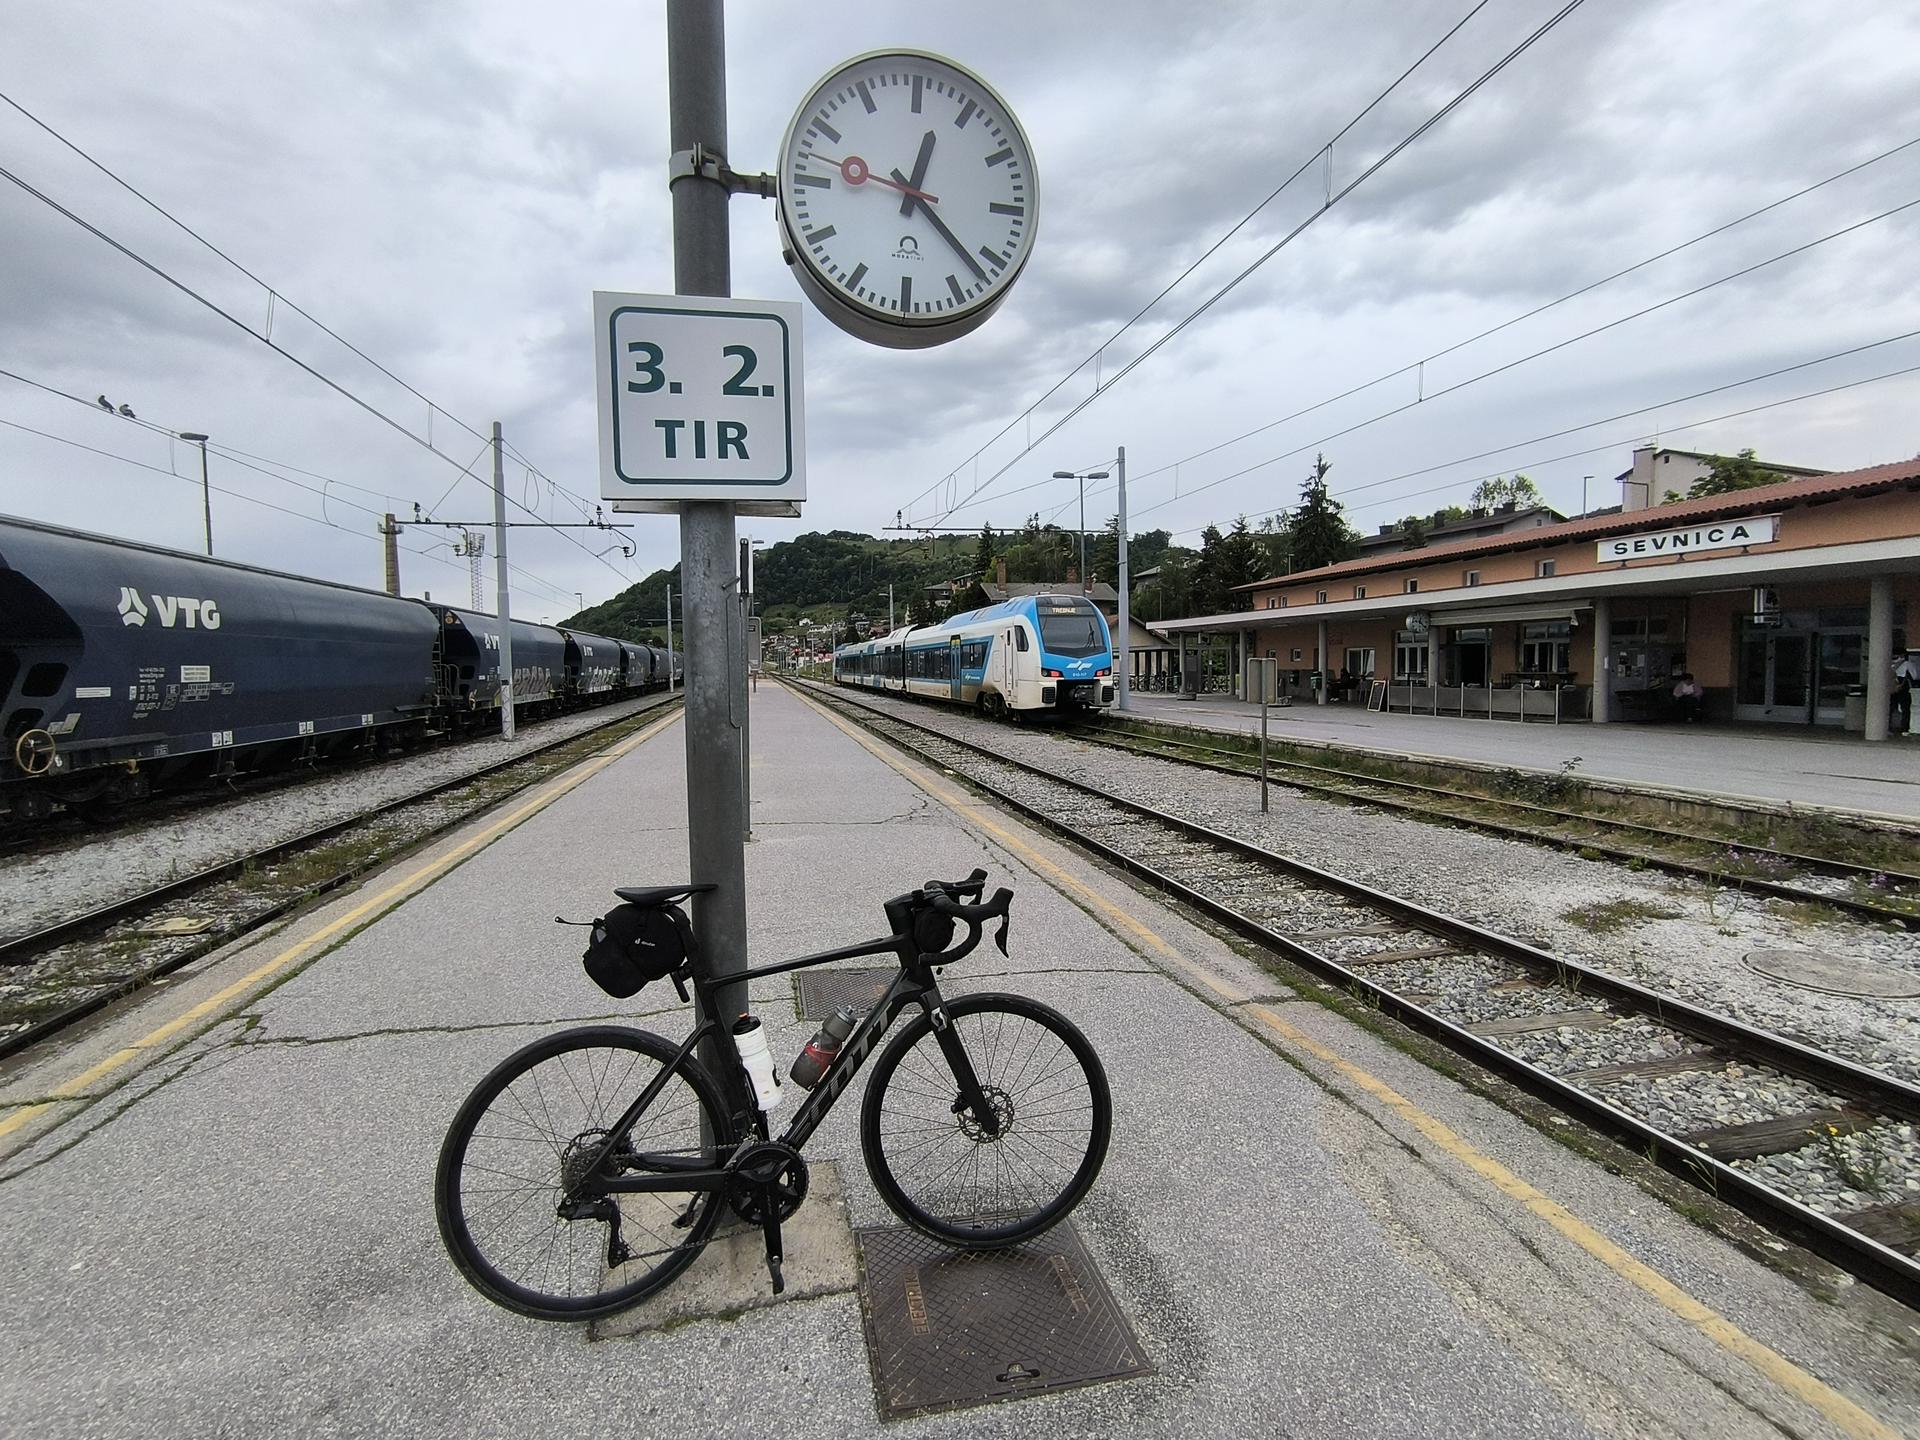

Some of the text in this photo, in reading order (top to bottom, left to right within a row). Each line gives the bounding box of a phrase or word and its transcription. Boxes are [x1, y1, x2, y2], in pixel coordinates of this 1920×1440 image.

[627, 341, 775, 397] 3. 2.
[654, 419, 750, 460] TIR
[1613, 524, 1751, 555] SEVNICA
[151, 594, 220, 629] VTG
